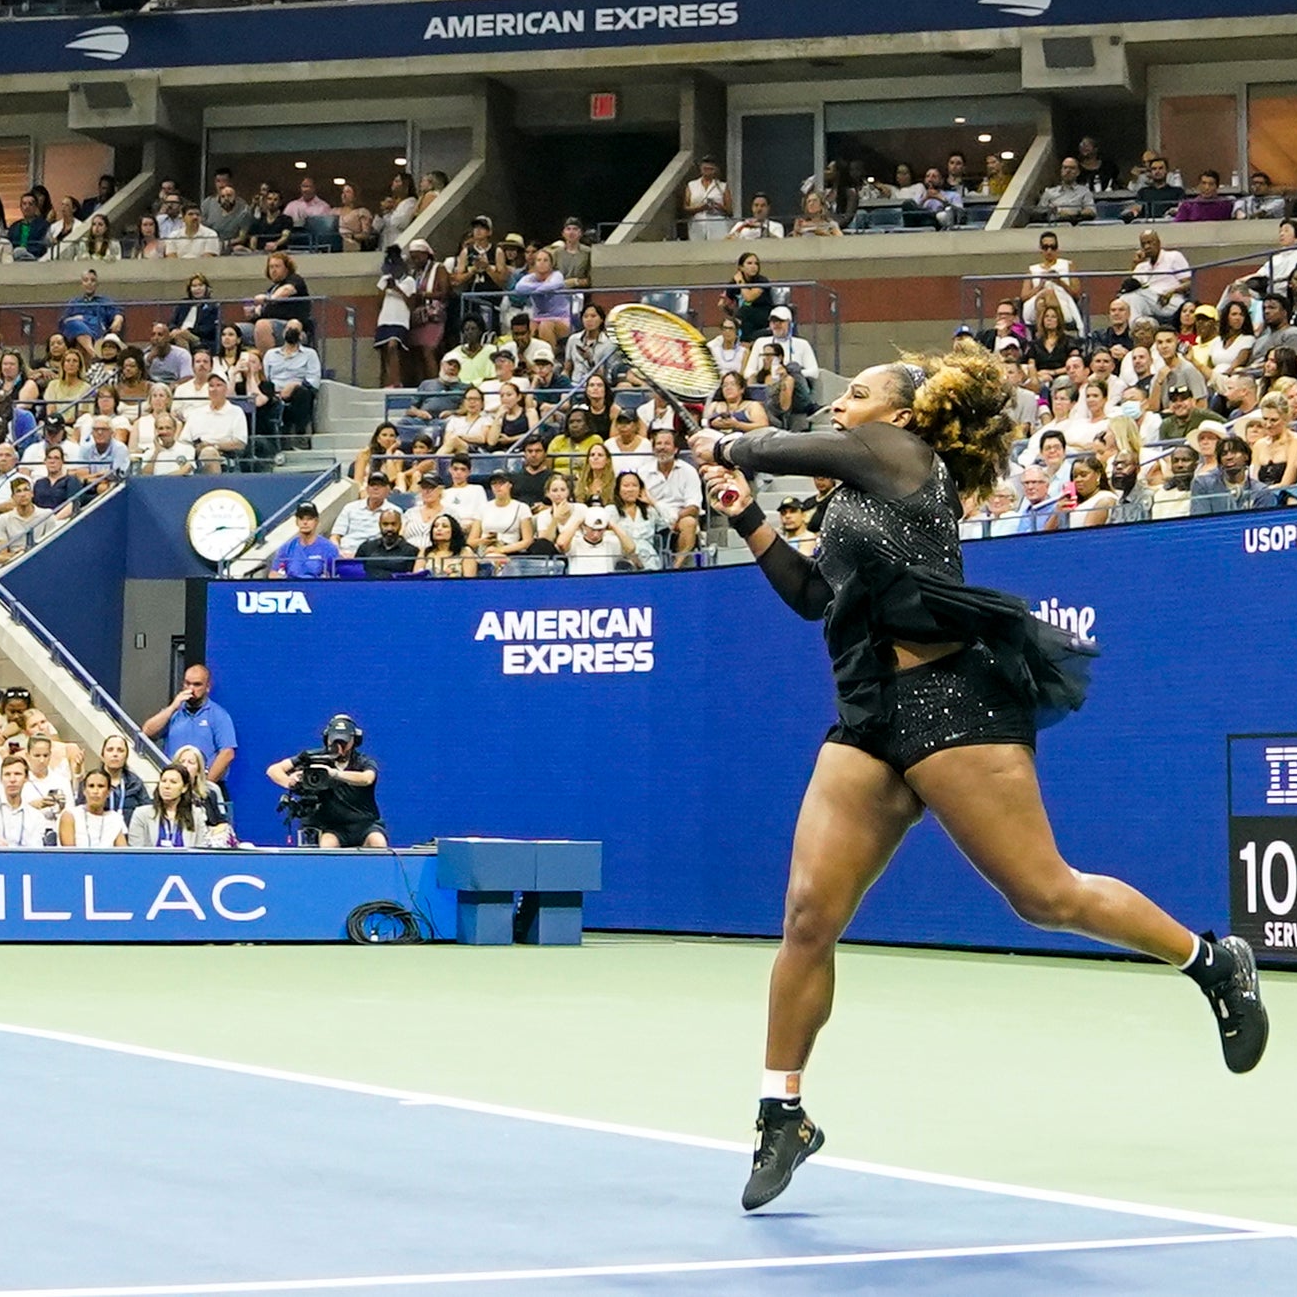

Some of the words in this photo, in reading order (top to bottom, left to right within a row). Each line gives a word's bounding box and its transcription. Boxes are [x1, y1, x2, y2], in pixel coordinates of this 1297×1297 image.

[423, 9, 585, 40] AMERICAN
[595, 2, 739, 32] EXPRESS
[236, 590, 312, 614] USTA
[474, 606, 654, 642] AMERICAN
[502, 642, 655, 675] EXPRESS
